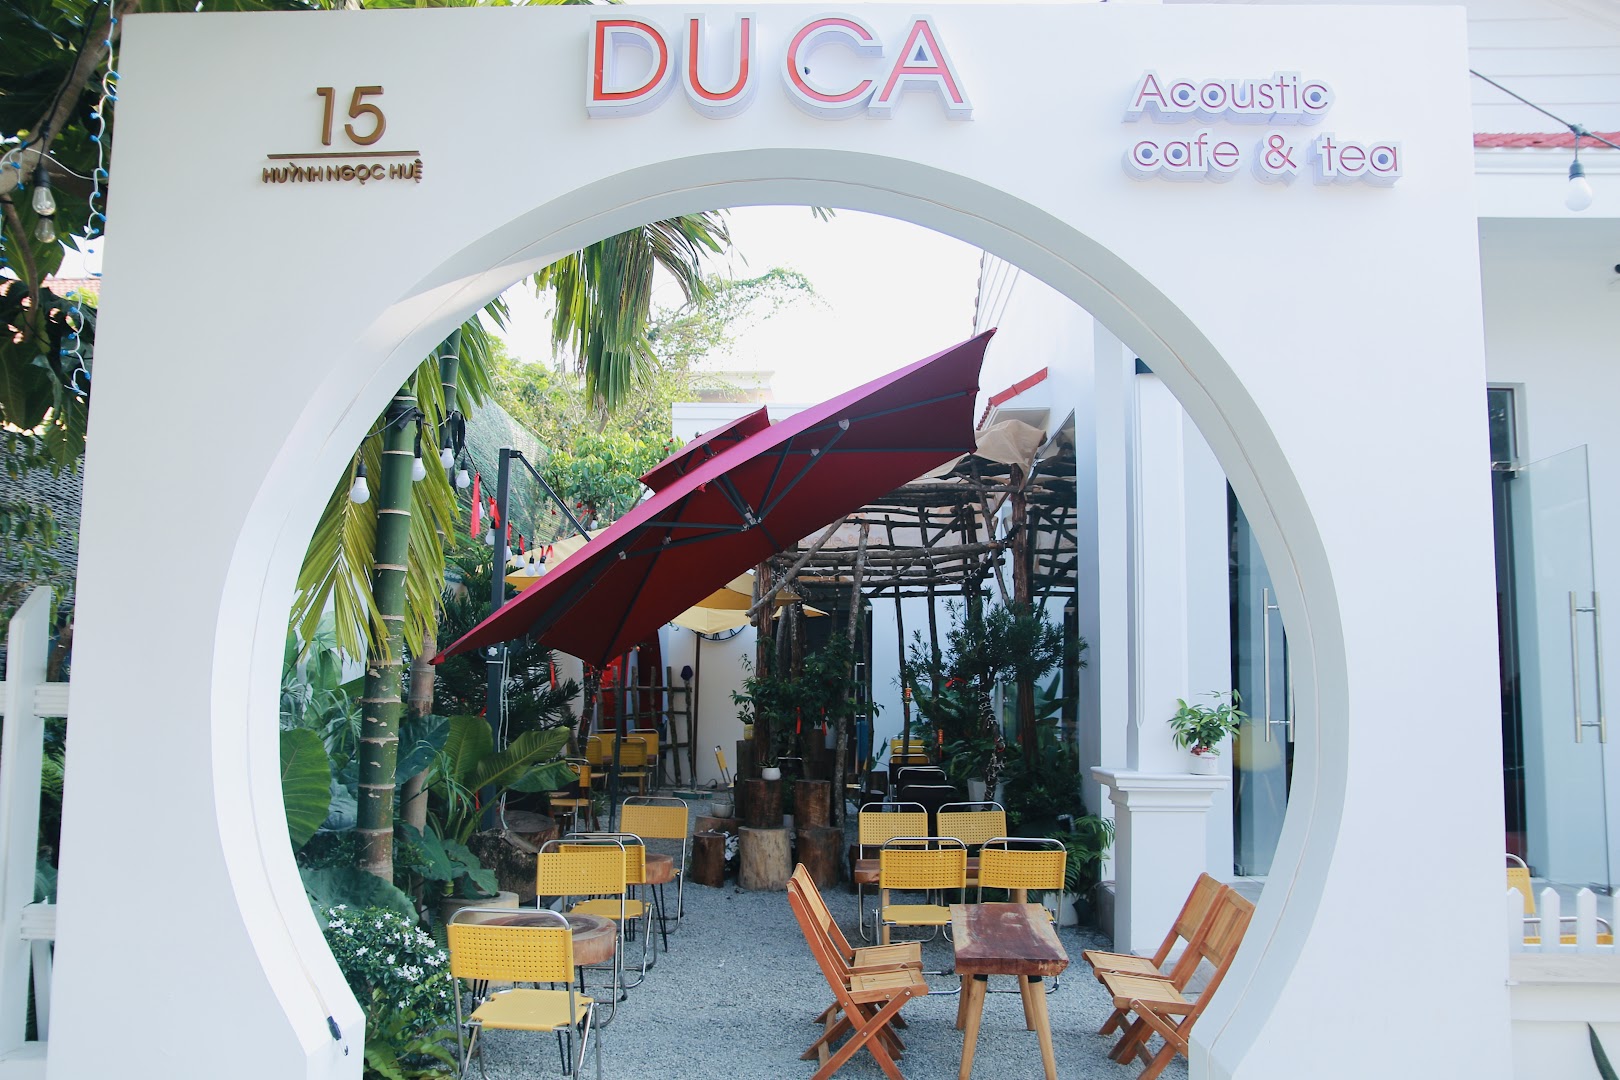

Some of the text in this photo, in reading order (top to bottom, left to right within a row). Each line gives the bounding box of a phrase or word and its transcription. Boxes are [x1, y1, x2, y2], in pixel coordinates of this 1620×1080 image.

[586, 12, 973, 114] DUCA
[1129, 70, 1334, 113] Acoustic
[316, 86, 387, 146] 15
[262, 158, 423, 185] HUỲNH NGỌC HUỆ
[1129, 129, 1401, 175] cafe & tea
